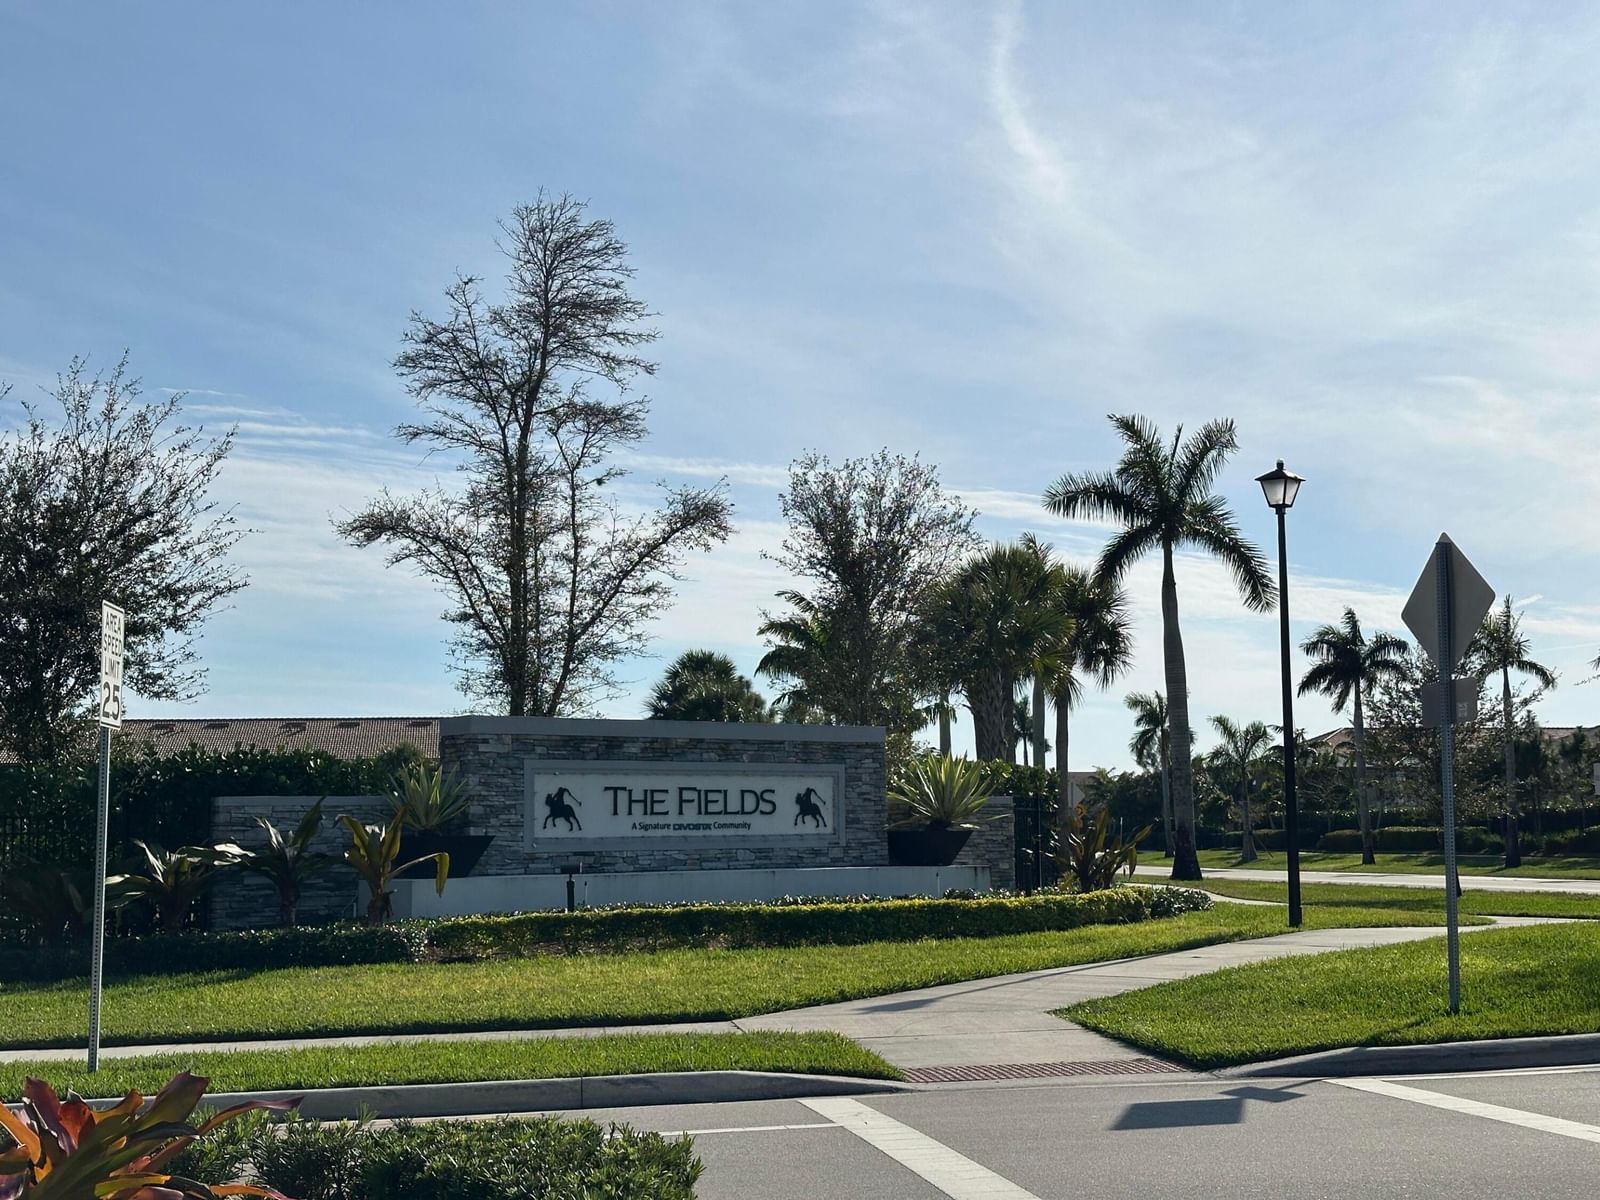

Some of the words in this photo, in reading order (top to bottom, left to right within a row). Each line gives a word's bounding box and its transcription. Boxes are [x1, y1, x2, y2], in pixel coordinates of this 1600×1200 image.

[105, 611, 121, 635] AREA
[104, 633, 122, 657] SPEED
[104, 655, 120, 679] LIMIT
[102, 681, 119, 720] 25
[604, 786, 669, 816] THE
[677, 786, 776, 816] FIELDS
[631, 822, 637, 830] A
[638, 822, 671, 832] Signature
[713, 820, 751, 831] Community
